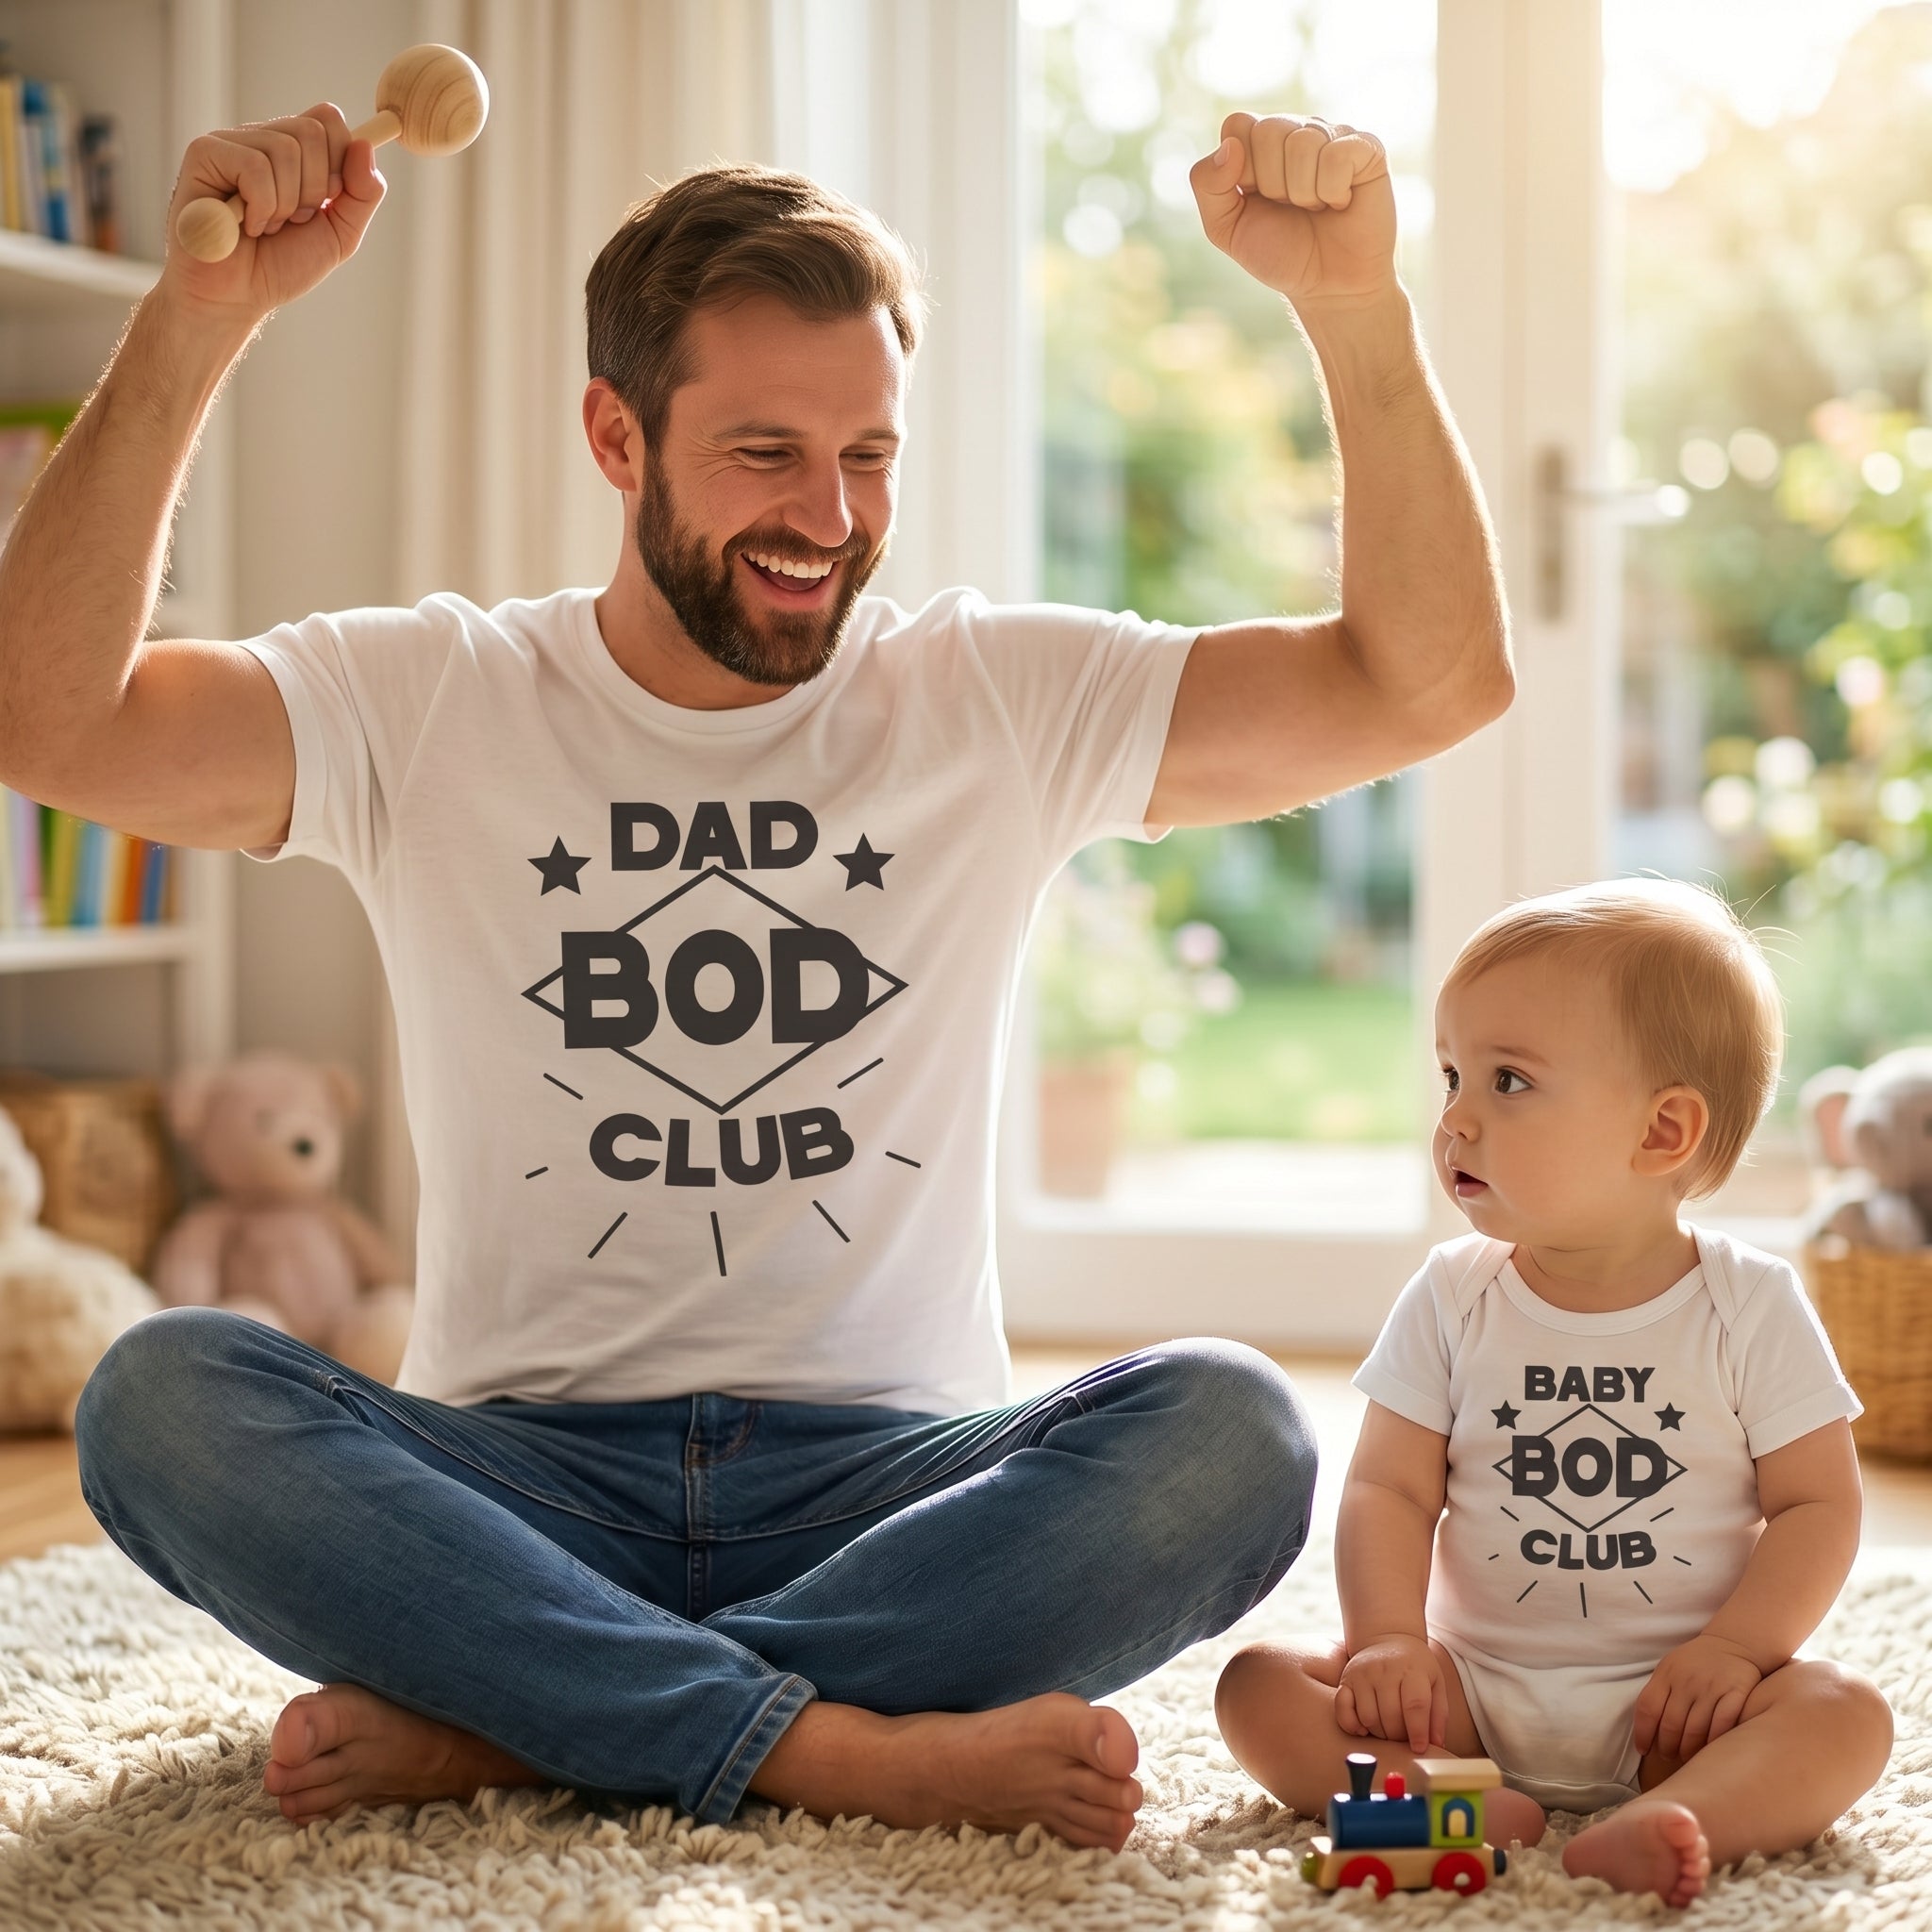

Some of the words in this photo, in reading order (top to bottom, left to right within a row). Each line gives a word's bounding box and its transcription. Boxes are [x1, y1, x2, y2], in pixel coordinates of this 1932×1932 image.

[609, 800, 819, 872] DAD
[560, 927, 870, 1049] BOD
[589, 1107, 855, 1188] CLUB
[1524, 1365, 1656, 1403] BABY
[1511, 1435, 1668, 1498] BOD
[1520, 1528, 1657, 1571] CLUB
